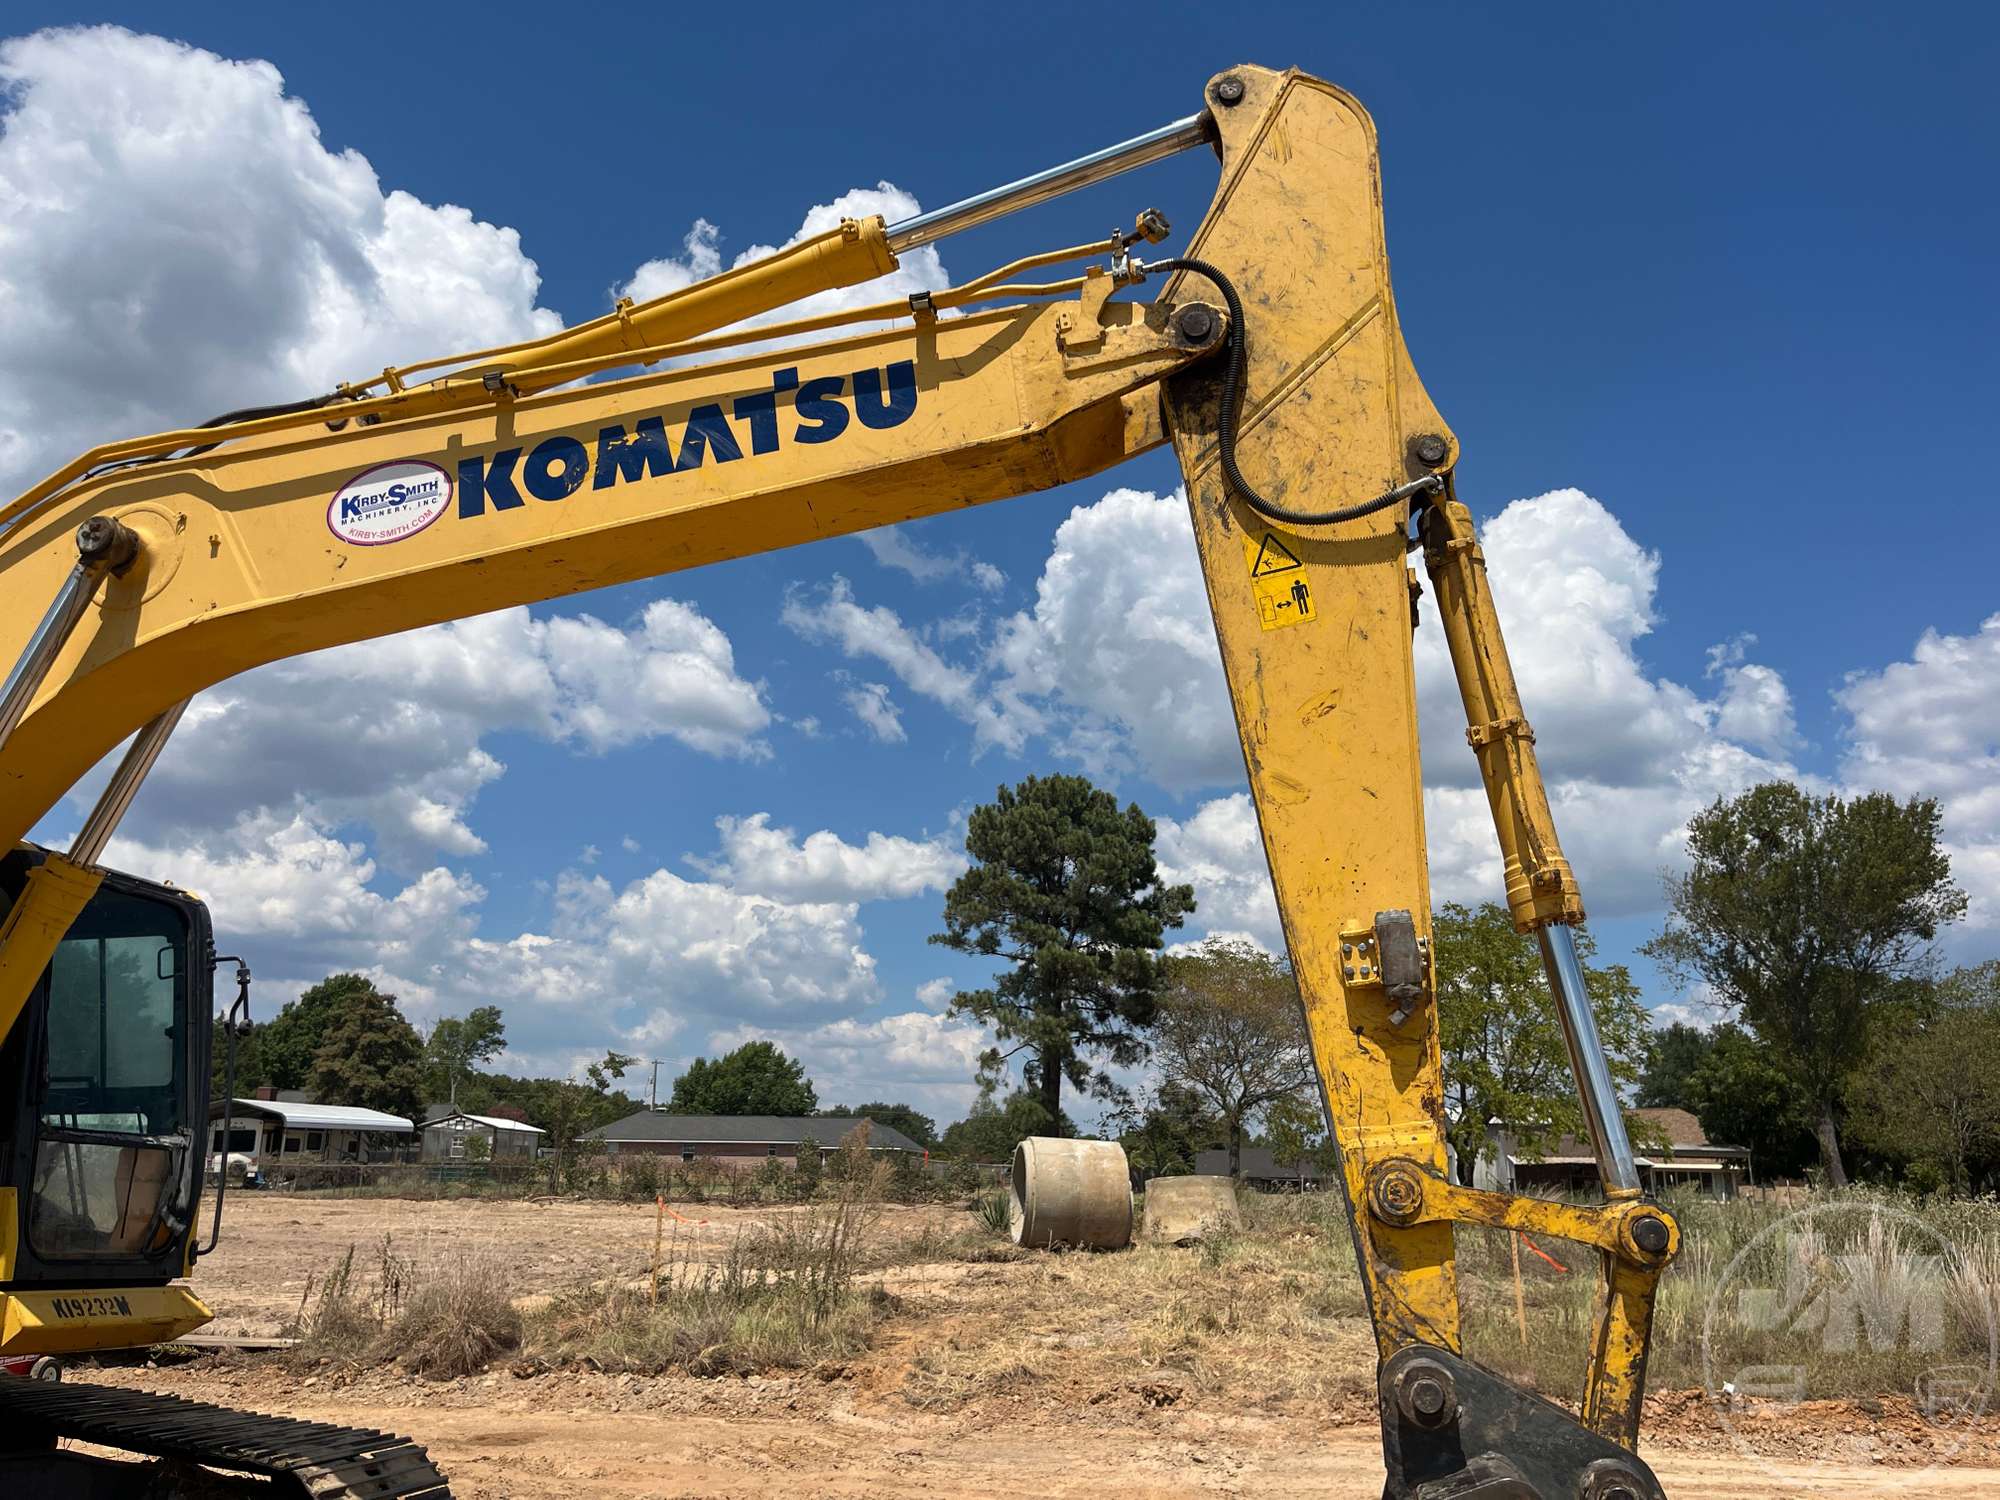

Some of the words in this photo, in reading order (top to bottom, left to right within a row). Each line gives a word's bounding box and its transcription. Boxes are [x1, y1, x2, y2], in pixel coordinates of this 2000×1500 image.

[458, 360, 918, 520] KOMATSU
[341, 504, 412, 526] MACHINERY,
[348, 508, 433, 539] KIRBY-SMITH.COM
